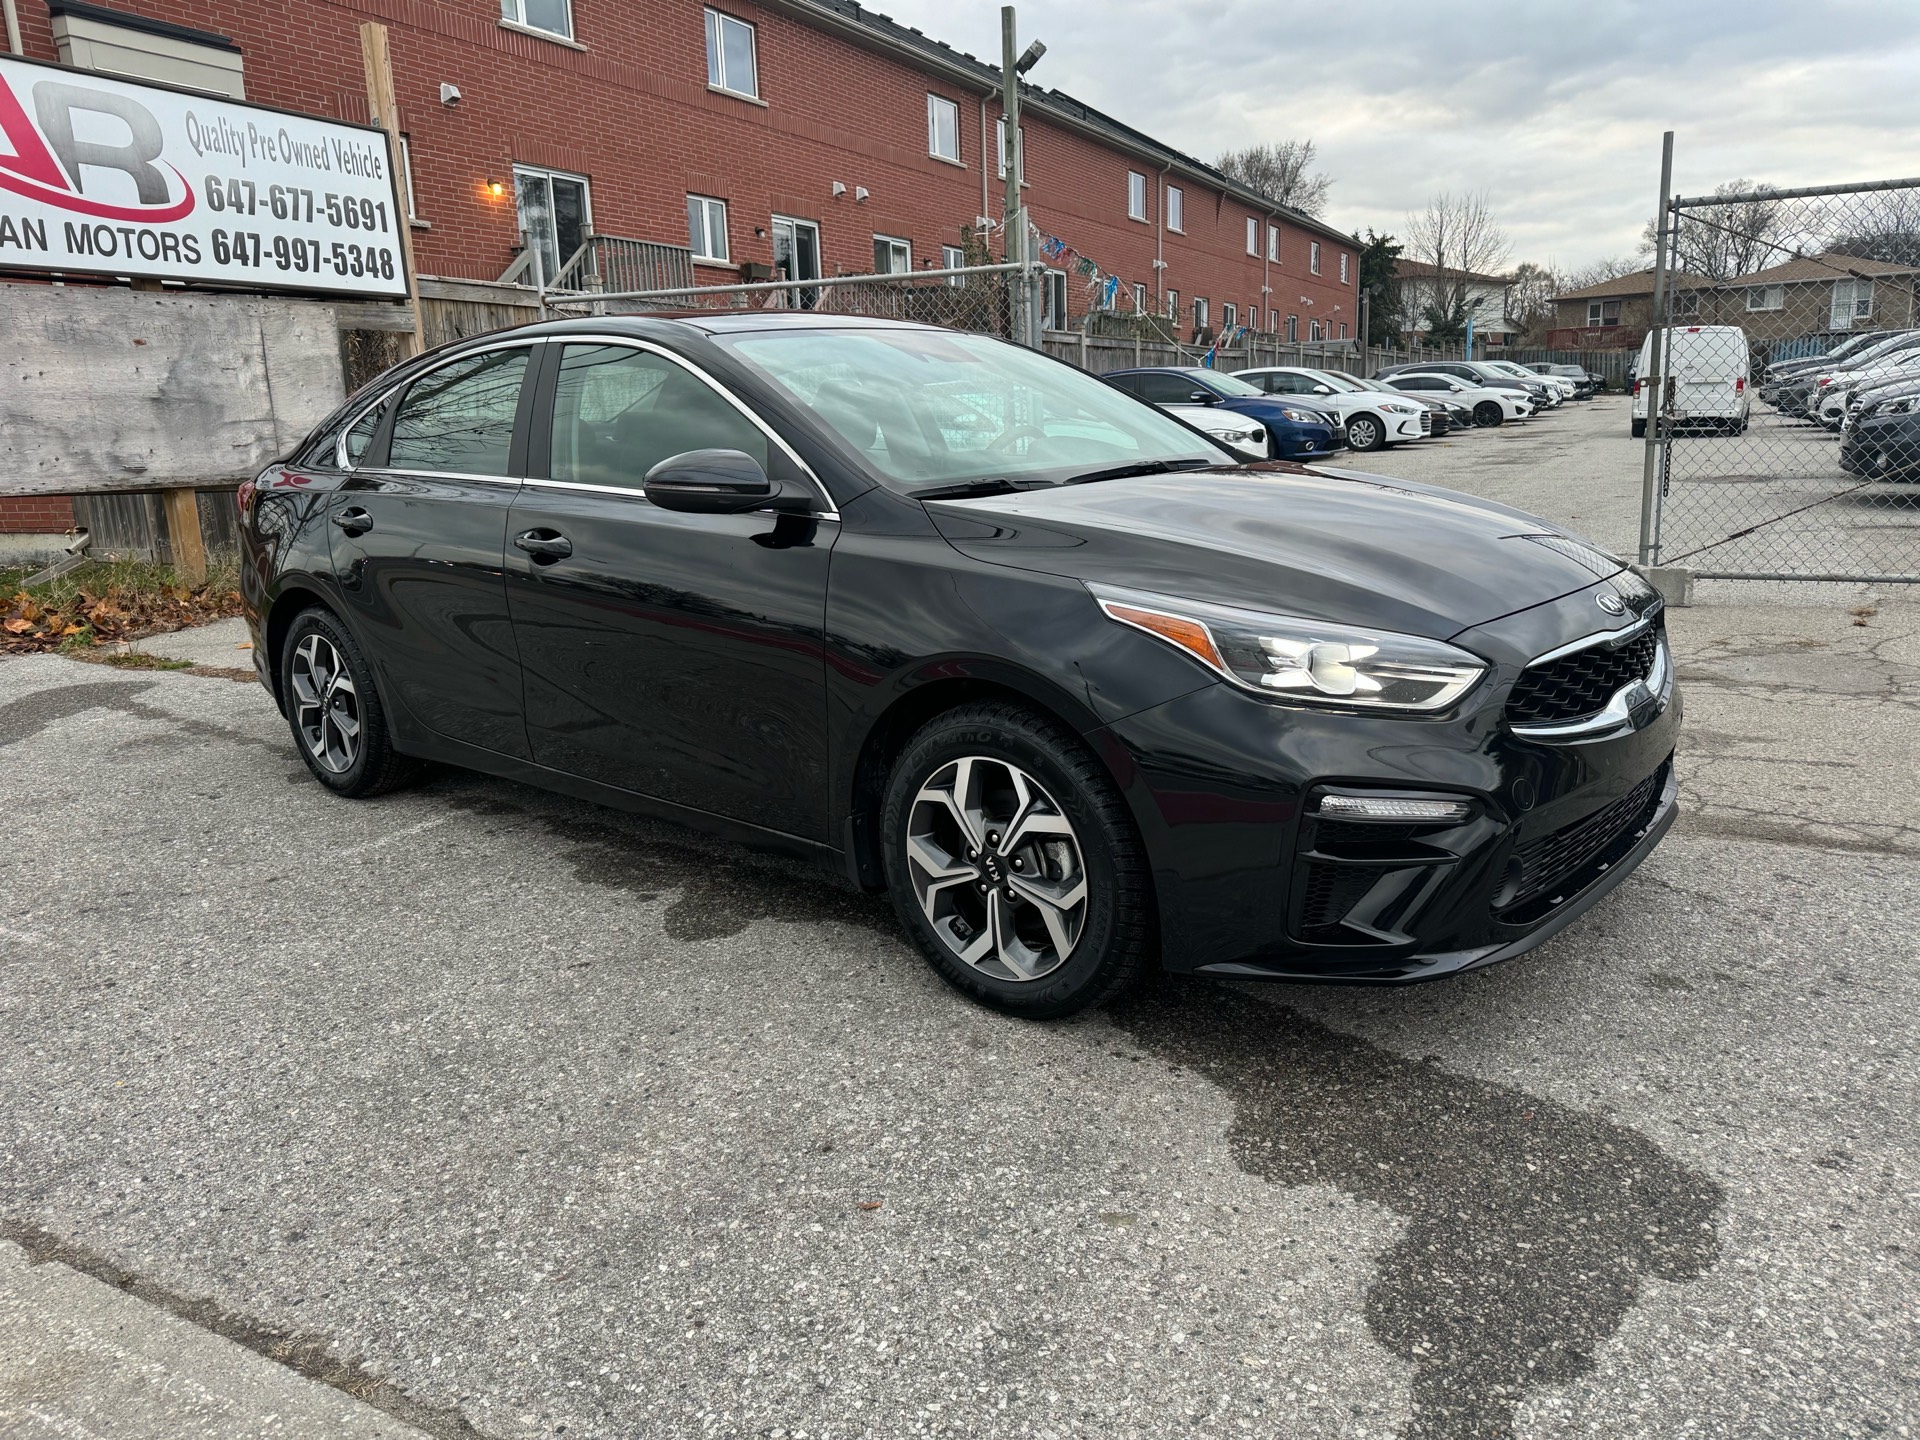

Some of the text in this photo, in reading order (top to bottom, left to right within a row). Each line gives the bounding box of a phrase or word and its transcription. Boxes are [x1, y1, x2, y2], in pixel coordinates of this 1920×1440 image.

[185, 110, 383, 181] Quality Pre Owned Vehicle
[204, 174, 389, 233] 647-677-5691
[0, 214, 202, 265] AN MOTORS
[211, 228, 395, 281] 647-997-5348
[985, 855, 1001, 882] KIA
